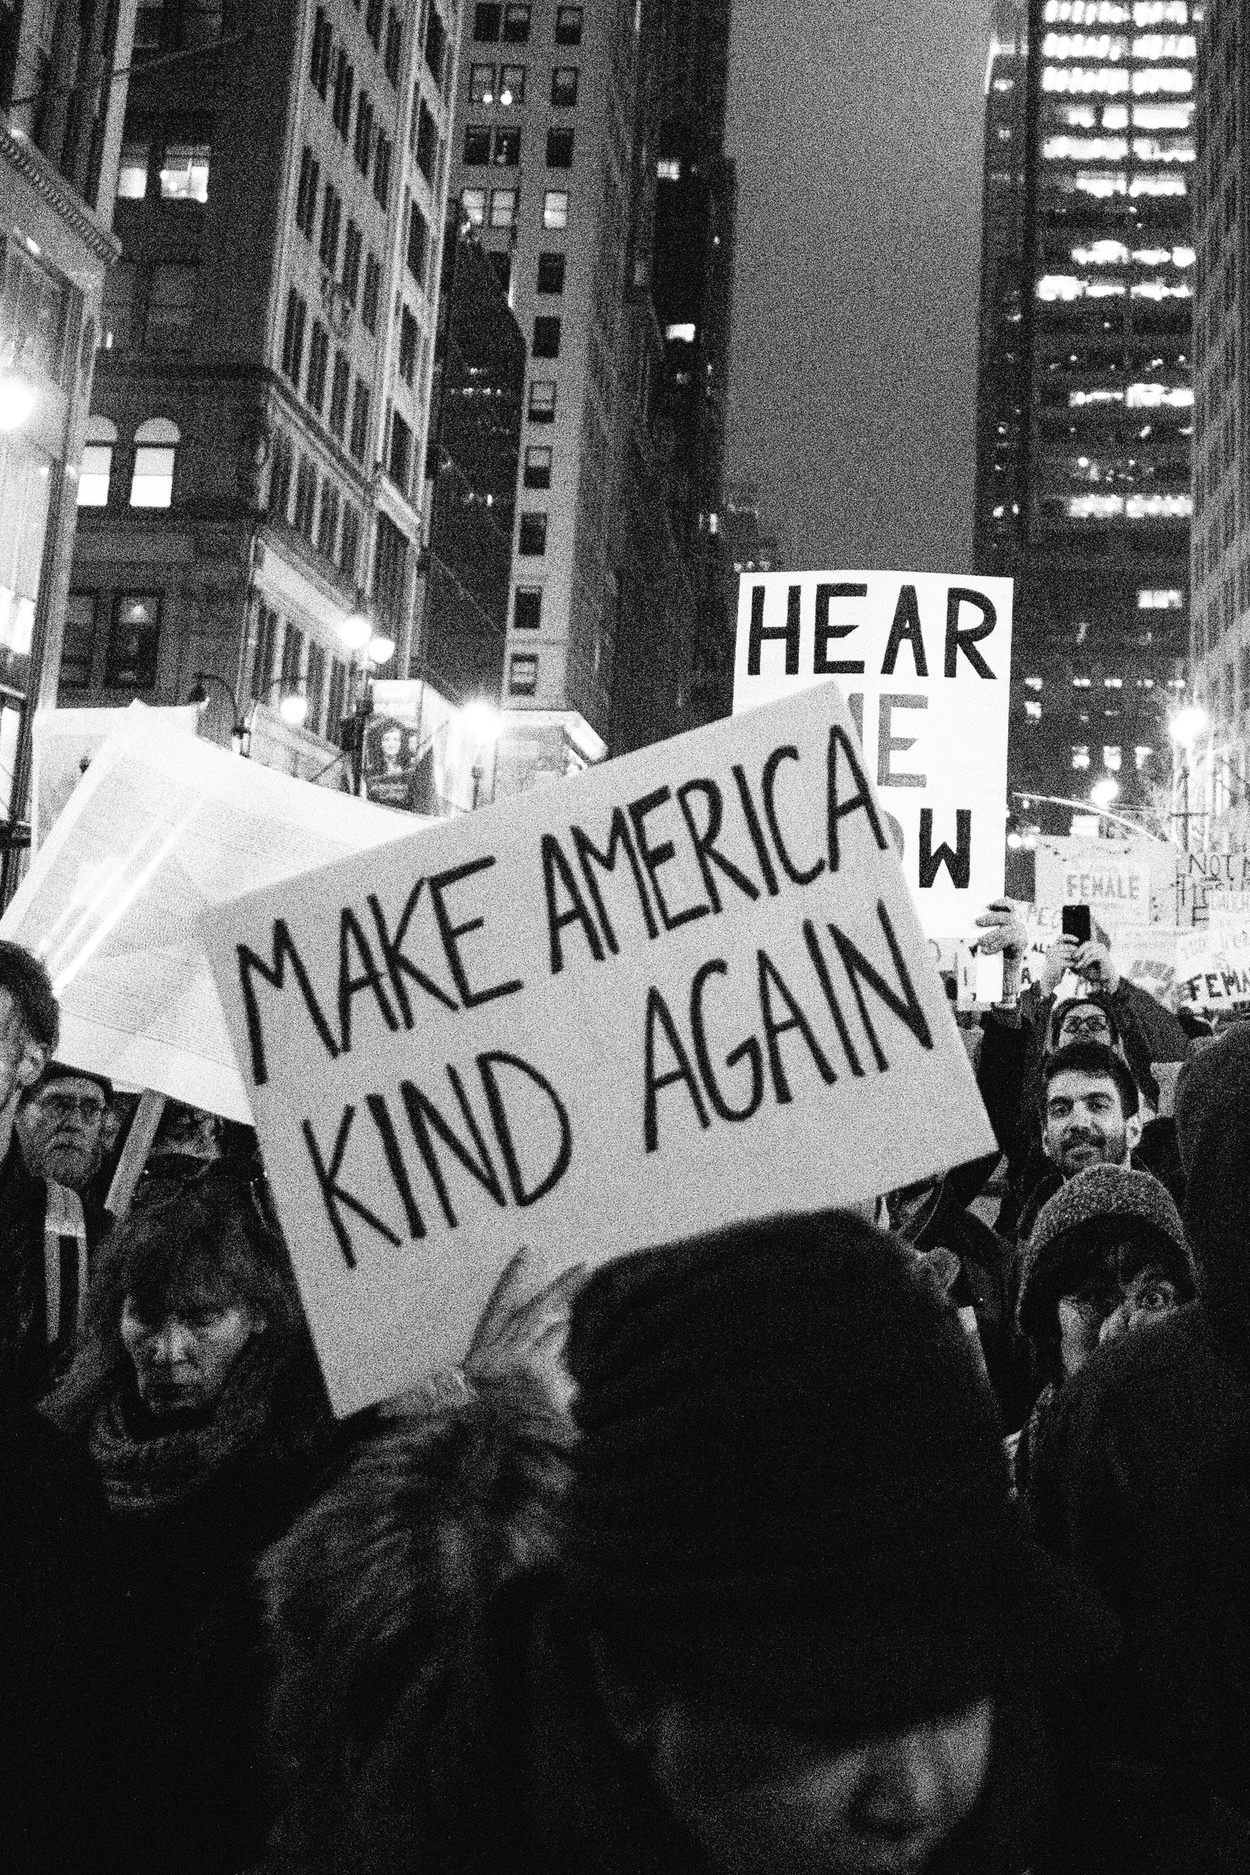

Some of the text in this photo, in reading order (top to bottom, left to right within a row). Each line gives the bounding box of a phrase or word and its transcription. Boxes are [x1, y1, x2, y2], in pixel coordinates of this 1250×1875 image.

[747, 583, 998, 679] HEAR
[236, 855, 524, 1085] MAKE
[540, 725, 888, 973] AMERICA
[1066, 873, 1140, 900] FEMALE
[1189, 854, 1235, 881] NOT
[302, 898, 932, 1269] KIND AGAIN
